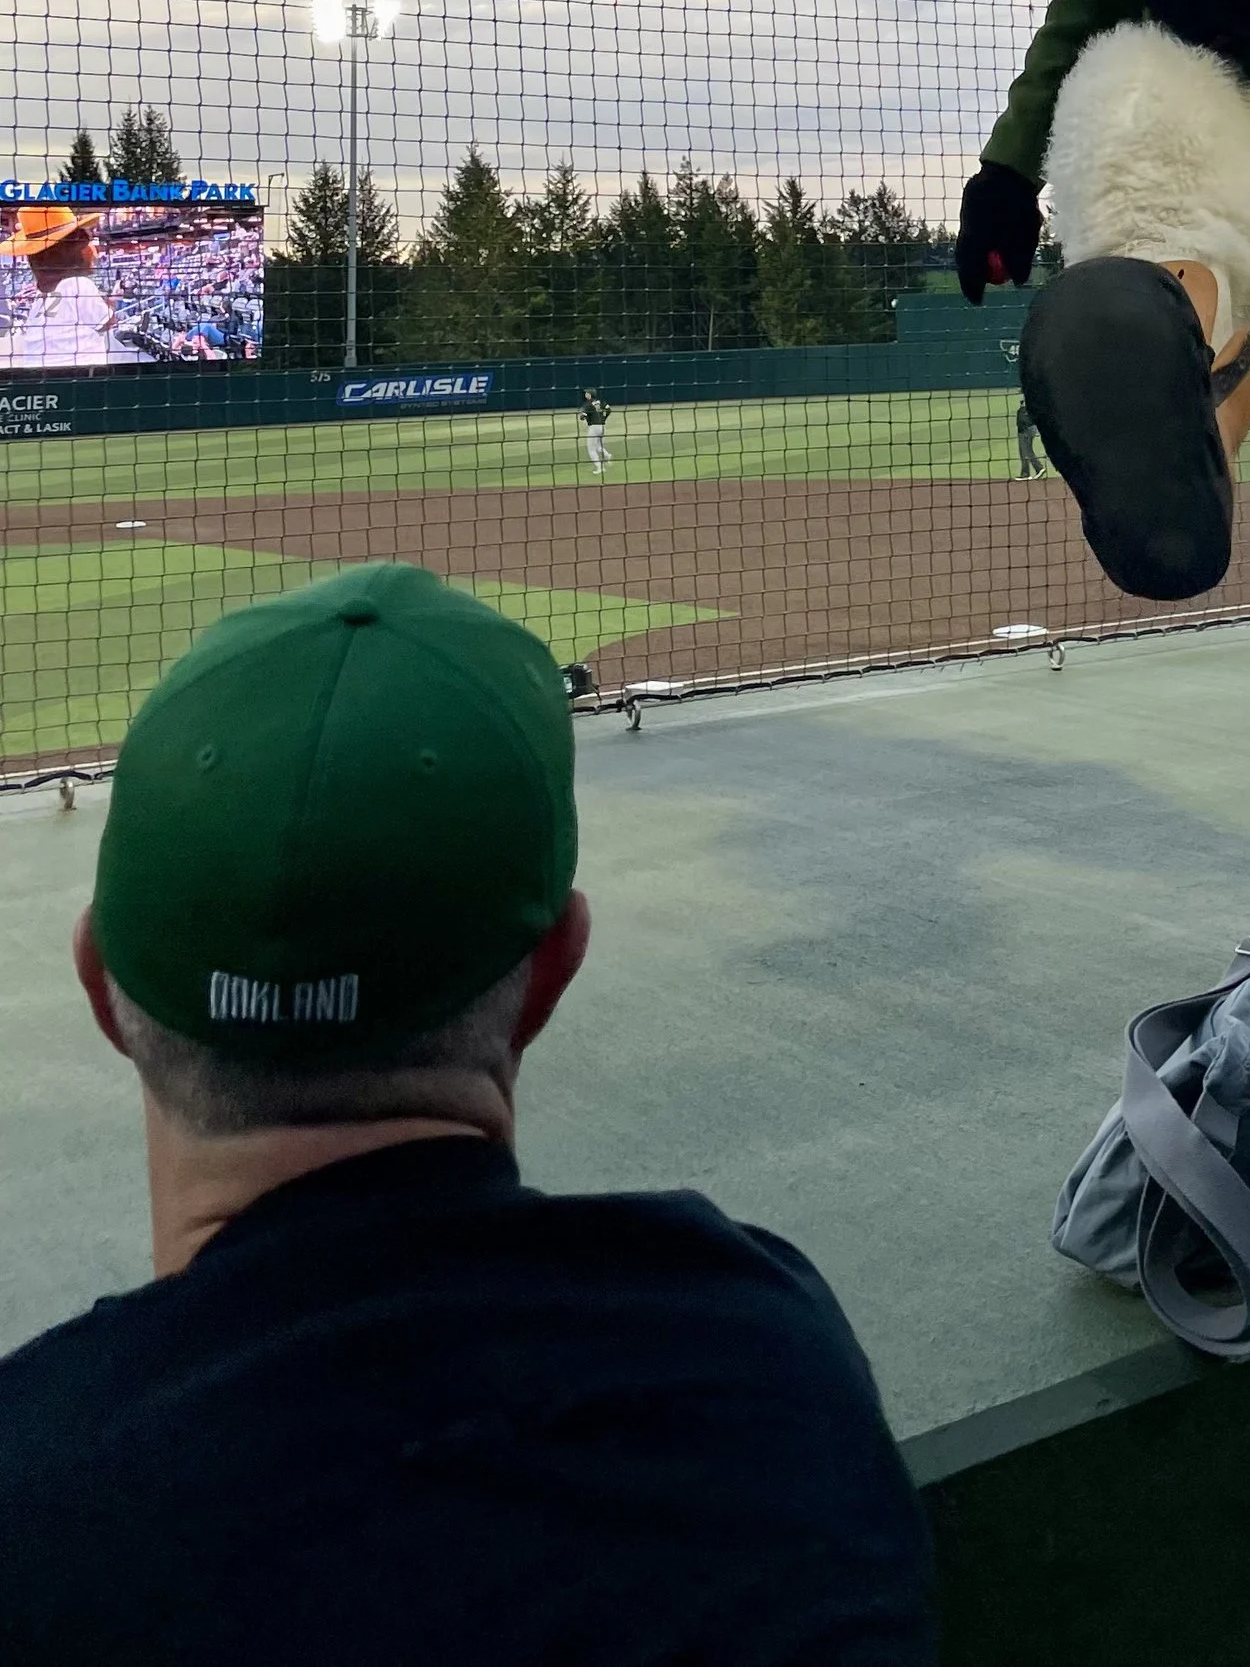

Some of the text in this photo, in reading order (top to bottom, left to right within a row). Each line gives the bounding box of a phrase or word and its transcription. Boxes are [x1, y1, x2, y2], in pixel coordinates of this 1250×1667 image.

[0, 179, 258, 202] GLACIER BANK PARK
[342, 376, 489, 403] CARLISLE
[0, 394, 59, 411] ACIER
[23, 423, 33, 433] &
[36, 422, 72, 433] LASIK
[210, 970, 359, 1023] OAKLAND
